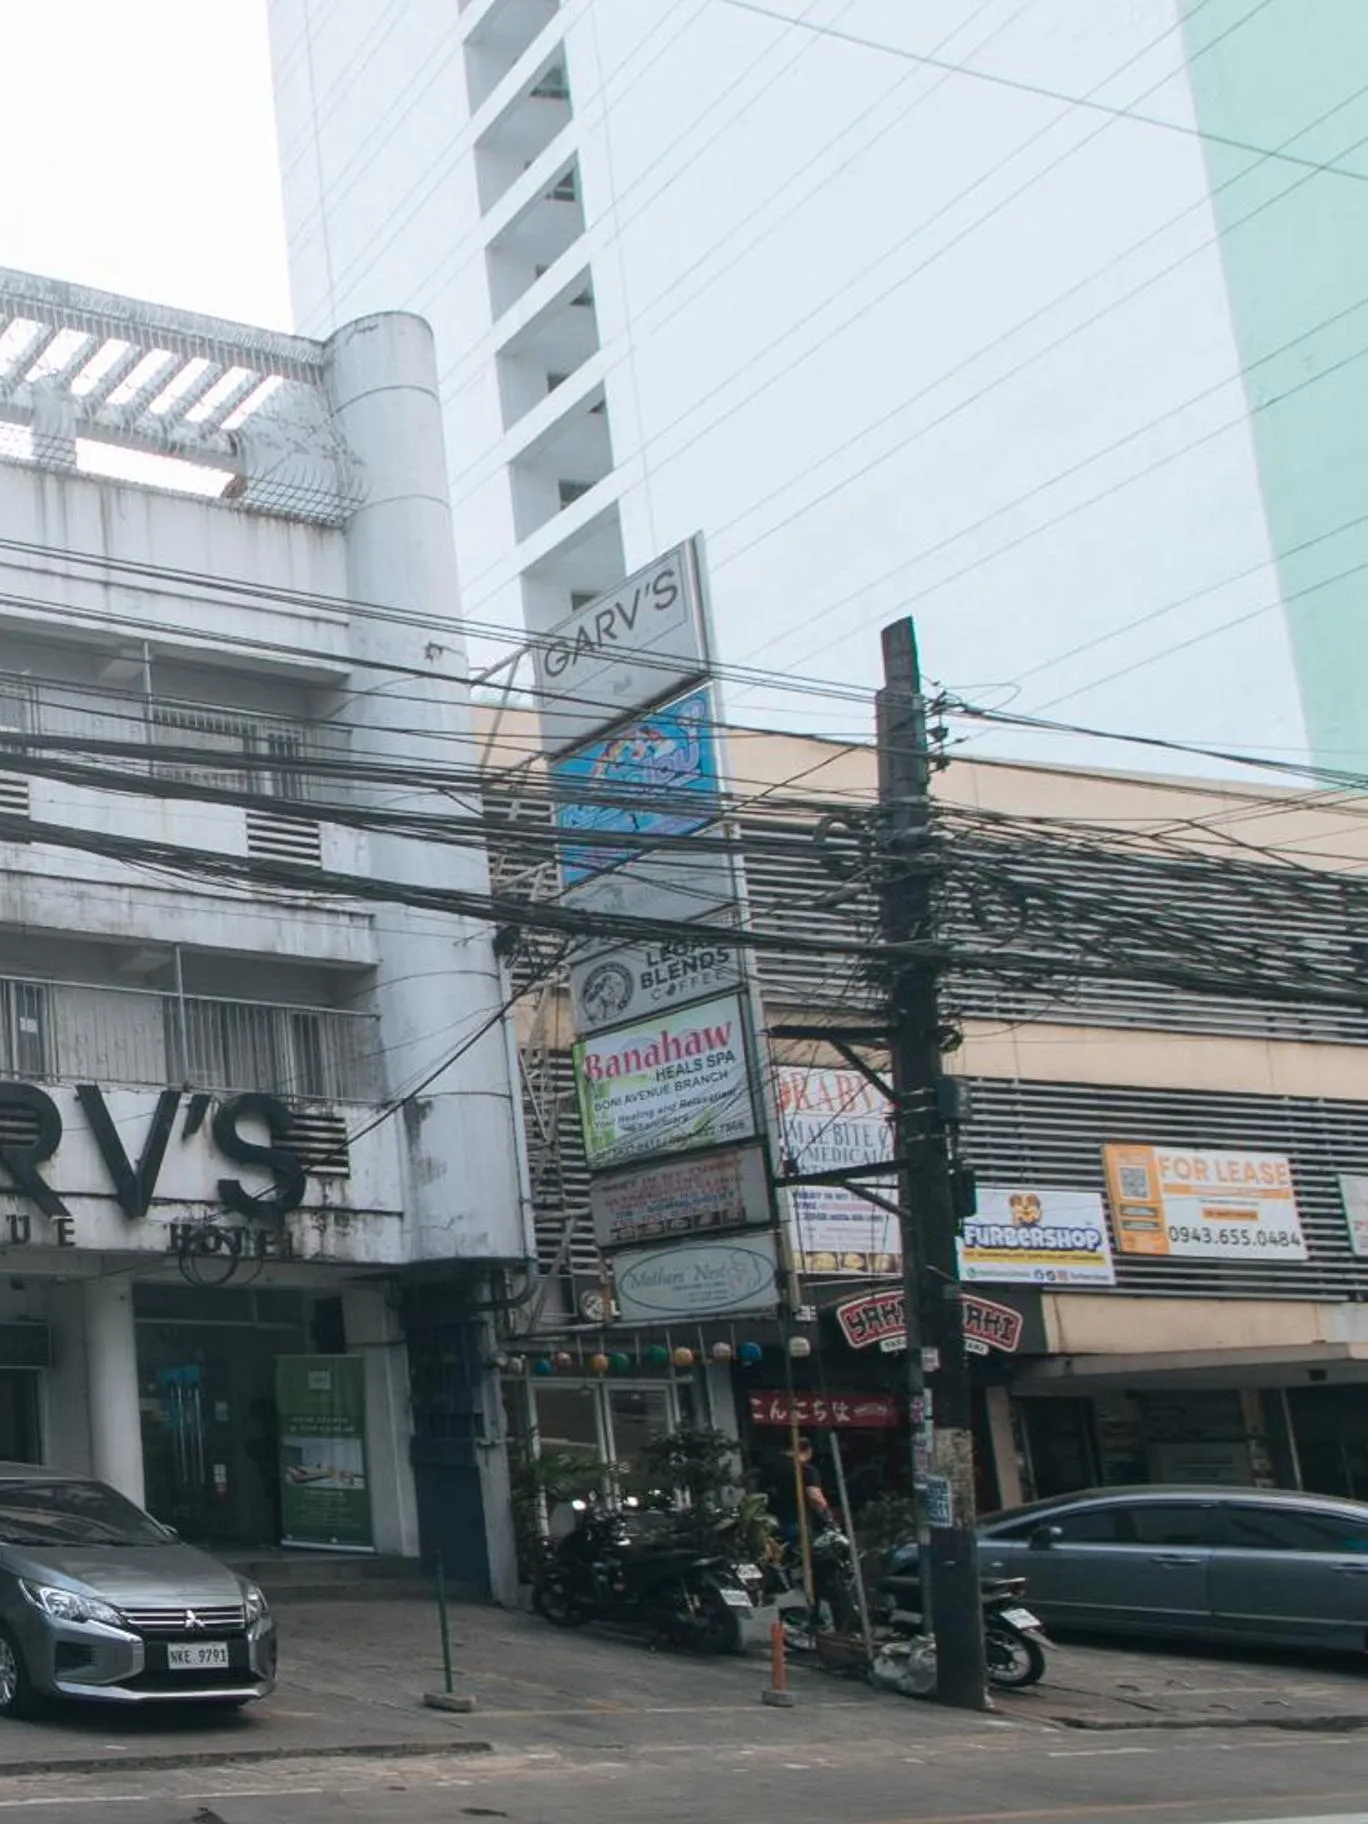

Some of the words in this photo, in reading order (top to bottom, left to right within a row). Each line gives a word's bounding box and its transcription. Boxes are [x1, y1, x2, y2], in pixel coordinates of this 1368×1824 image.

[543, 568, 679, 678] GARV'S
[640, 947, 731, 990] BLENDS
[584, 1020, 733, 1081] Banahaw
[655, 1057, 704, 1082] HEALS
[706, 1050, 737, 1067] SPA
[593, 1095, 624, 1112] BONI
[624, 1083, 671, 1107] AVENUE
[674, 1069, 729, 1091] BRANCH
[1158, 1155, 1211, 1182] FOR
[1214, 1159, 1290, 1186] LEASE
[1167, 1225, 1302, 1247] 0943.655.0484
